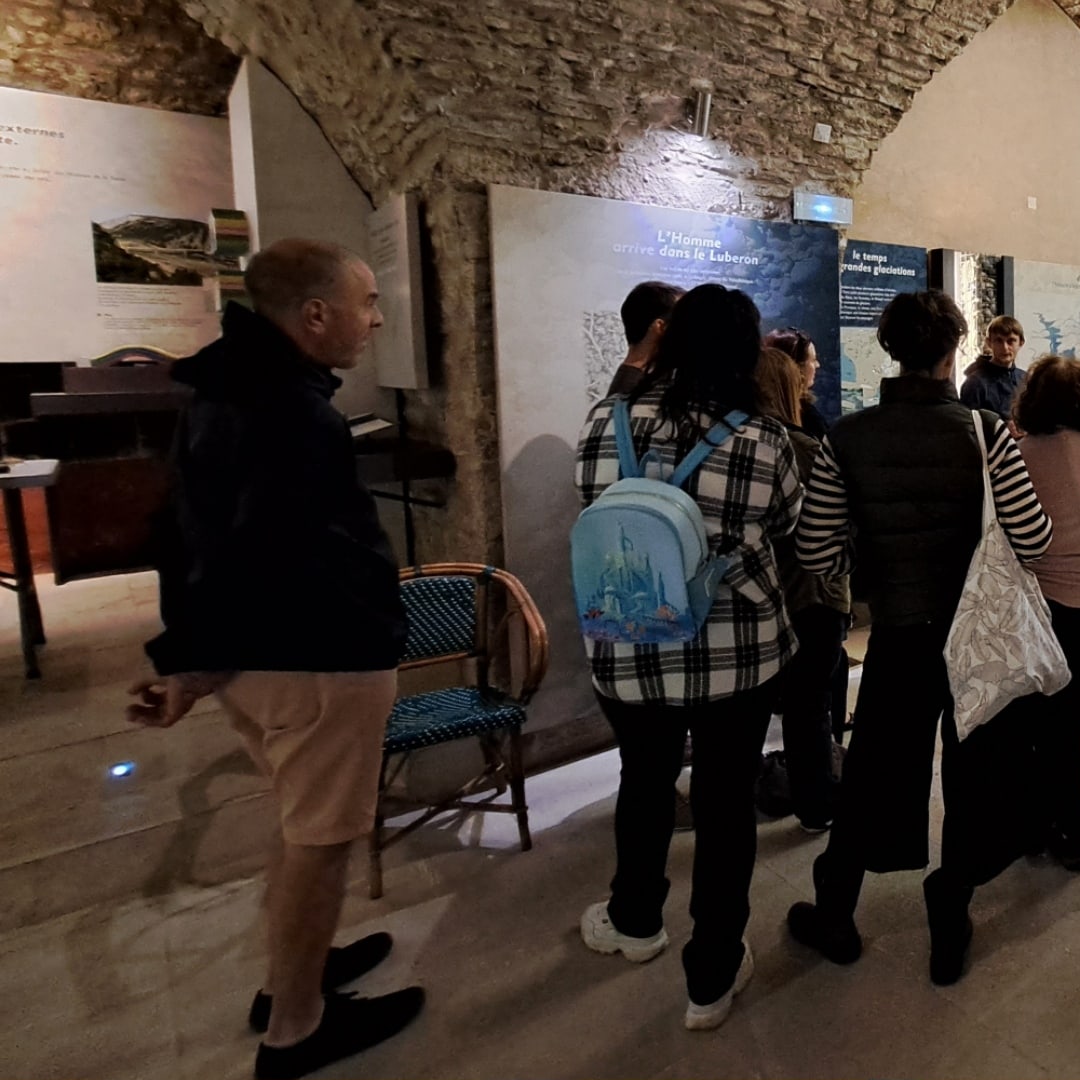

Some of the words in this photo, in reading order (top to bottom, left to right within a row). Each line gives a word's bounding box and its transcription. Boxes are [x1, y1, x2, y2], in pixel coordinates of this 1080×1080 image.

[612, 243, 655, 256] arrive
[659, 245, 691, 259] dans
[694, 248, 706, 261] le
[710, 250, 759, 265] Luberon
[852, 249, 862, 260] le
[863, 252, 888, 264] temps
[873, 265, 916, 277] glaciations
